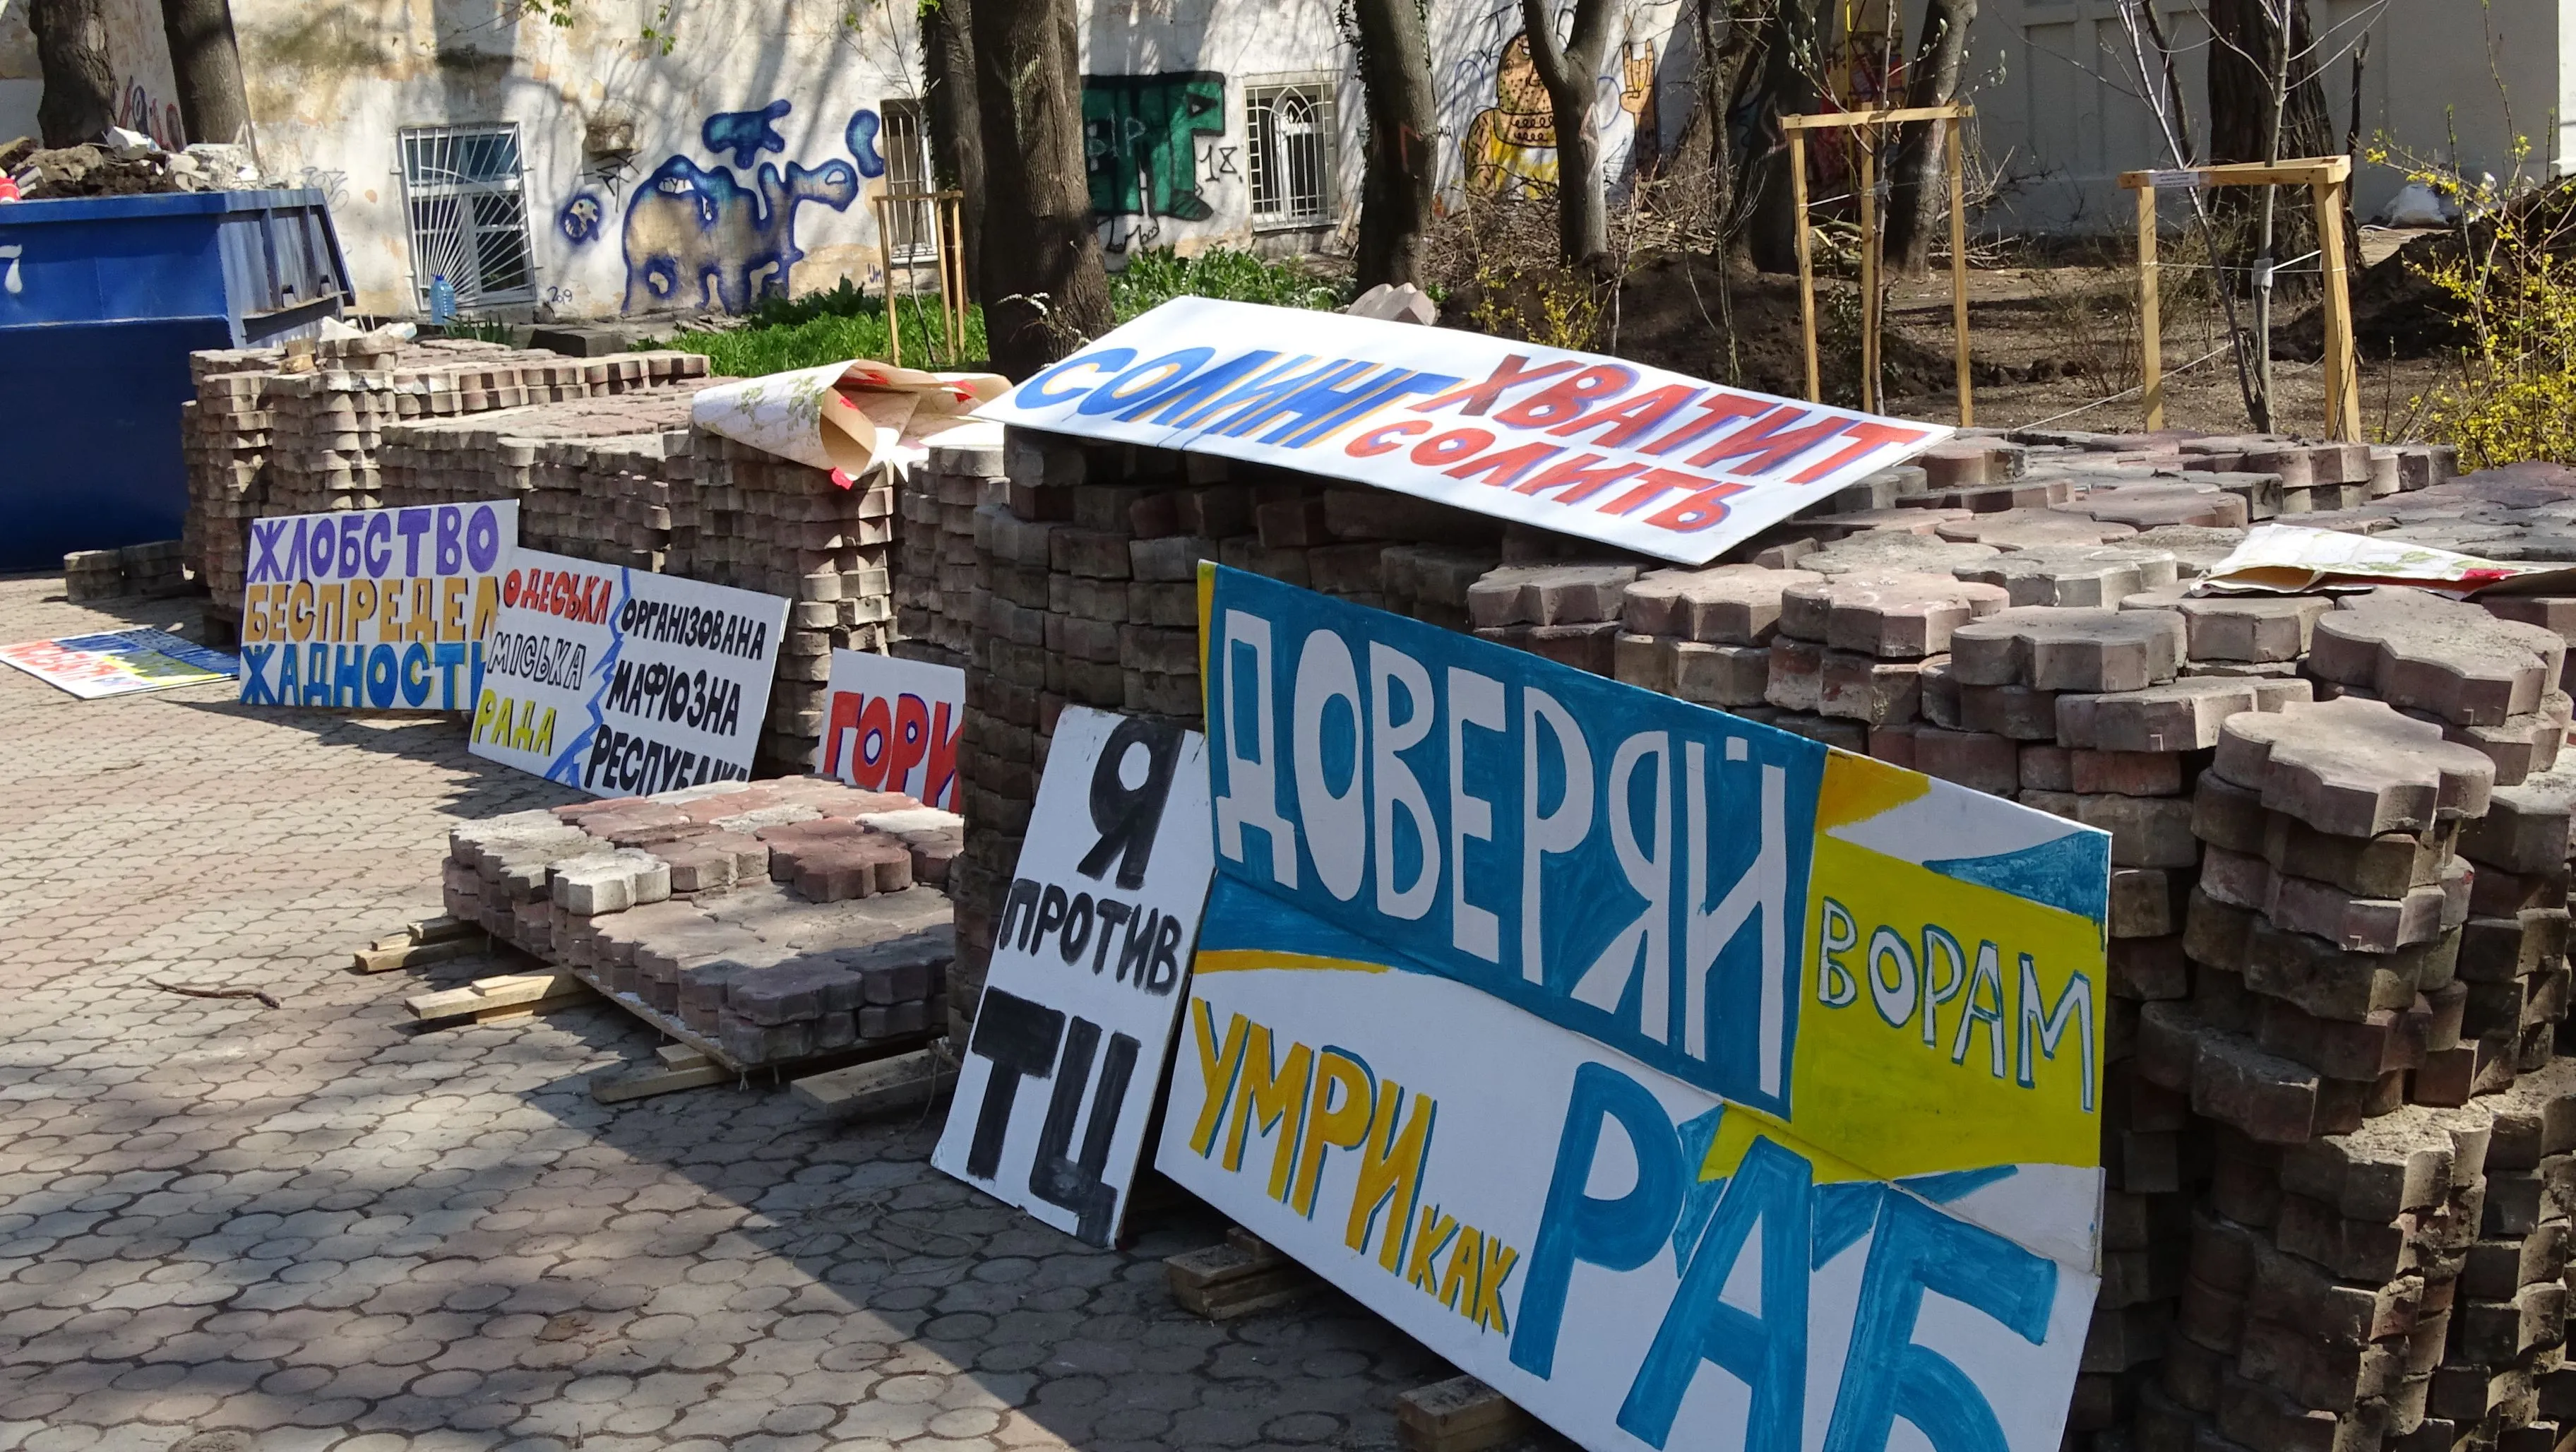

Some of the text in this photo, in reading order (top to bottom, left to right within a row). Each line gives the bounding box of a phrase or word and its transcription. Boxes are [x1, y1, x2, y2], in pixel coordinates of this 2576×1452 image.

[1015, 346, 1470, 450] СОЛИНГ
[1407, 353, 1929, 486] ХВАТИТ
[1344, 419, 1755, 533] СОЛИТЬ
[248, 504, 499, 583] ЖЛОБСТВО
[503, 568, 613, 625] ОДЕСЬКА
[244, 576, 500, 643] БЕСПРЕДЕЛ
[487, 631, 587, 691] МІСЬКА
[621, 598, 767, 661] ОРГАНІЗОВАНА
[472, 688, 556, 756] РАДА
[605, 659, 741, 737] МАФІОЗНА
[1077, 715, 1185, 891] Я
[1215, 607, 1789, 1100] ДОВЕРЯЙ
[998, 878, 1182, 996] ПРОТИВ
[1818, 895, 2096, 1114] ВОРАМ
[966, 986, 1141, 1248] ТЦ
[1188, 996, 1438, 1277] УМРИ
[1508, 1061, 2059, 1452] РАБ
